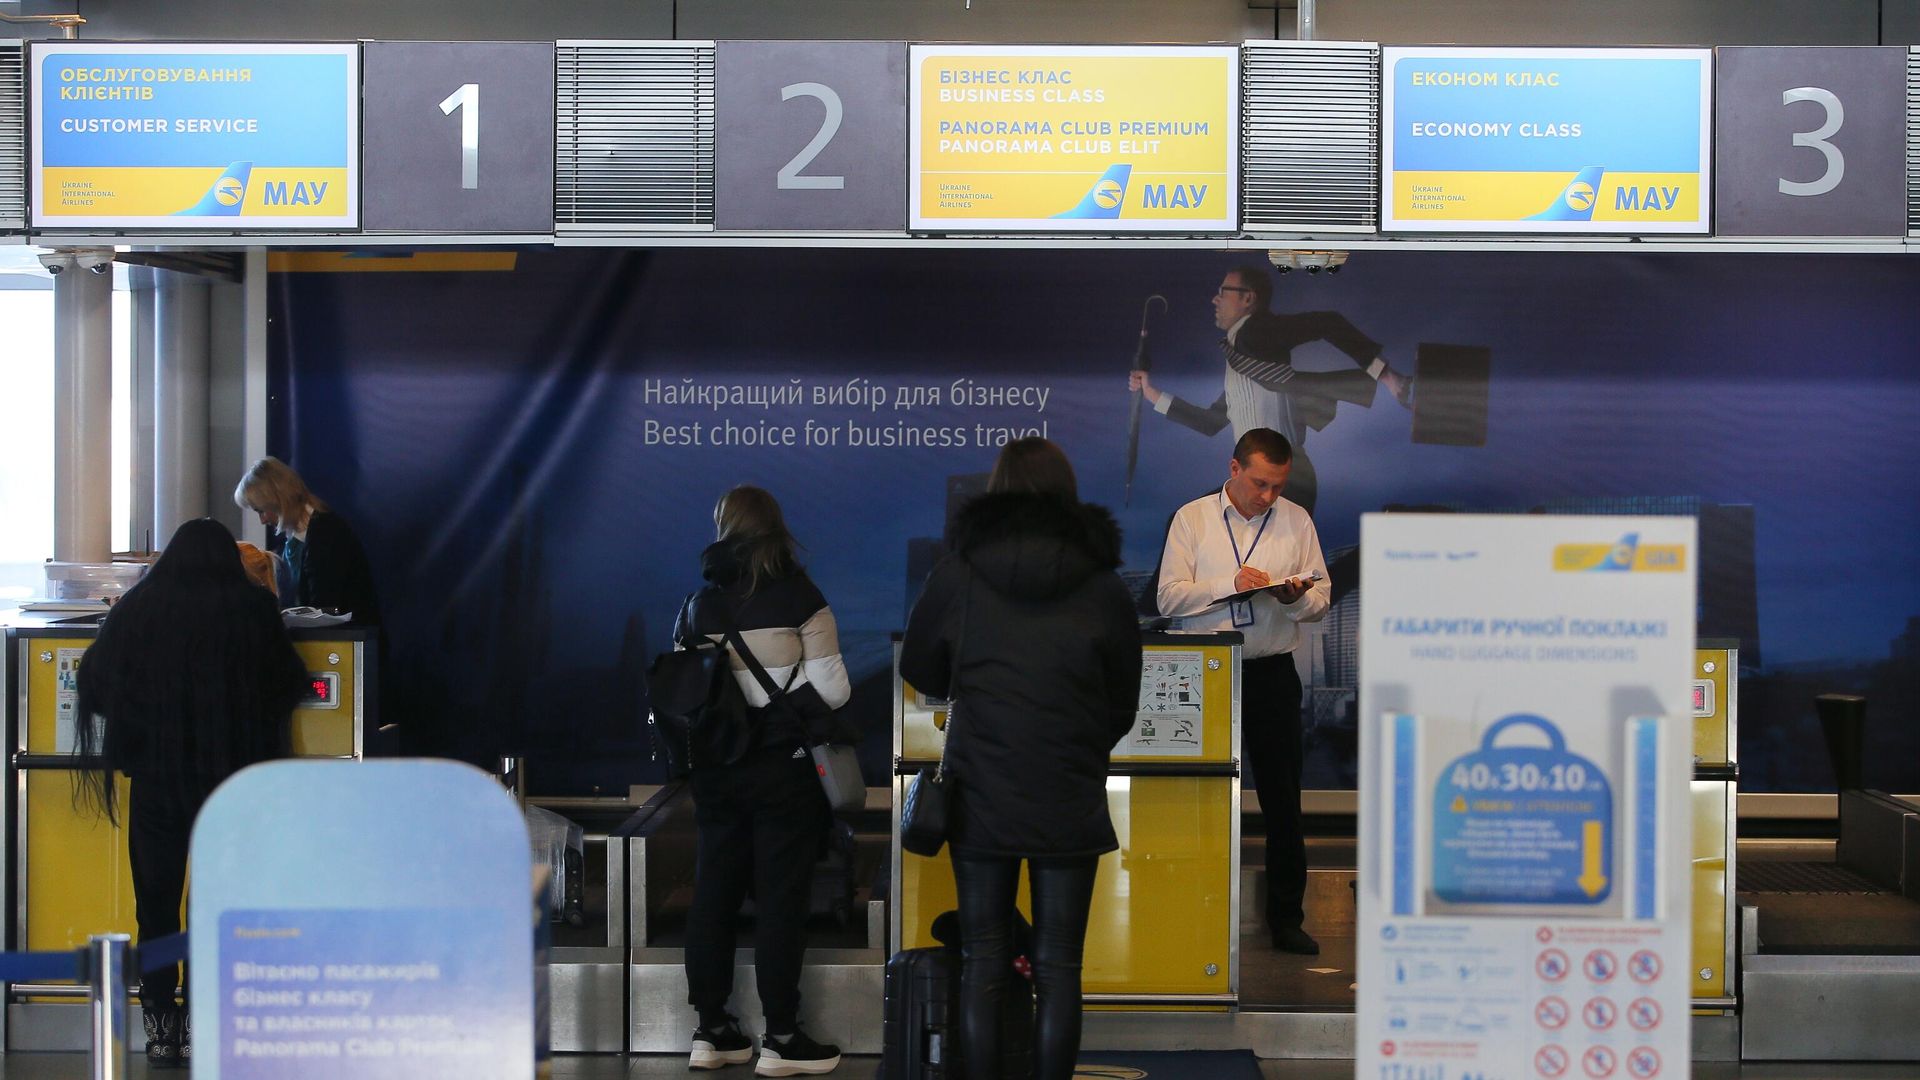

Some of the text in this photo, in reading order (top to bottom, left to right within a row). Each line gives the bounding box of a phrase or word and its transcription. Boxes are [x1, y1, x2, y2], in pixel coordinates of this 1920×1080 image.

[60, 68, 252, 83] ОБСЛУГОВУВАННЯ
[939, 70, 1073, 85] БІЗНЕС КЛАС
[1411, 72, 1560, 86] ЕКОНОМ КЛАС
[60, 86, 154, 100] КЛІЄНТІВ
[939, 88, 1106, 104] BUSINESS CLASS
[60, 118, 259, 134] CUSTOMER SERVICE
[939, 121, 1210, 137] PANORAMA CLUB PREMIUM
[1411, 122, 1582, 138] ECONOMY CLASS
[438, 83, 480, 190] 1
[777, 82, 845, 190] 2
[1778, 86, 1845, 197] 3
[939, 139, 1161, 155] PANORAMA CLUB ELIT
[263, 181, 329, 206] МАУ
[1142, 184, 1209, 209] МАУ
[1614, 186, 1680, 211] МАУ
[644, 378, 1050, 413] Найкращий вибір для бізнесу
[644, 419, 702, 446] Best
[710, 419, 796, 447] choice
[805, 419, 840, 446] for
[848, 419, 967, 447] business
